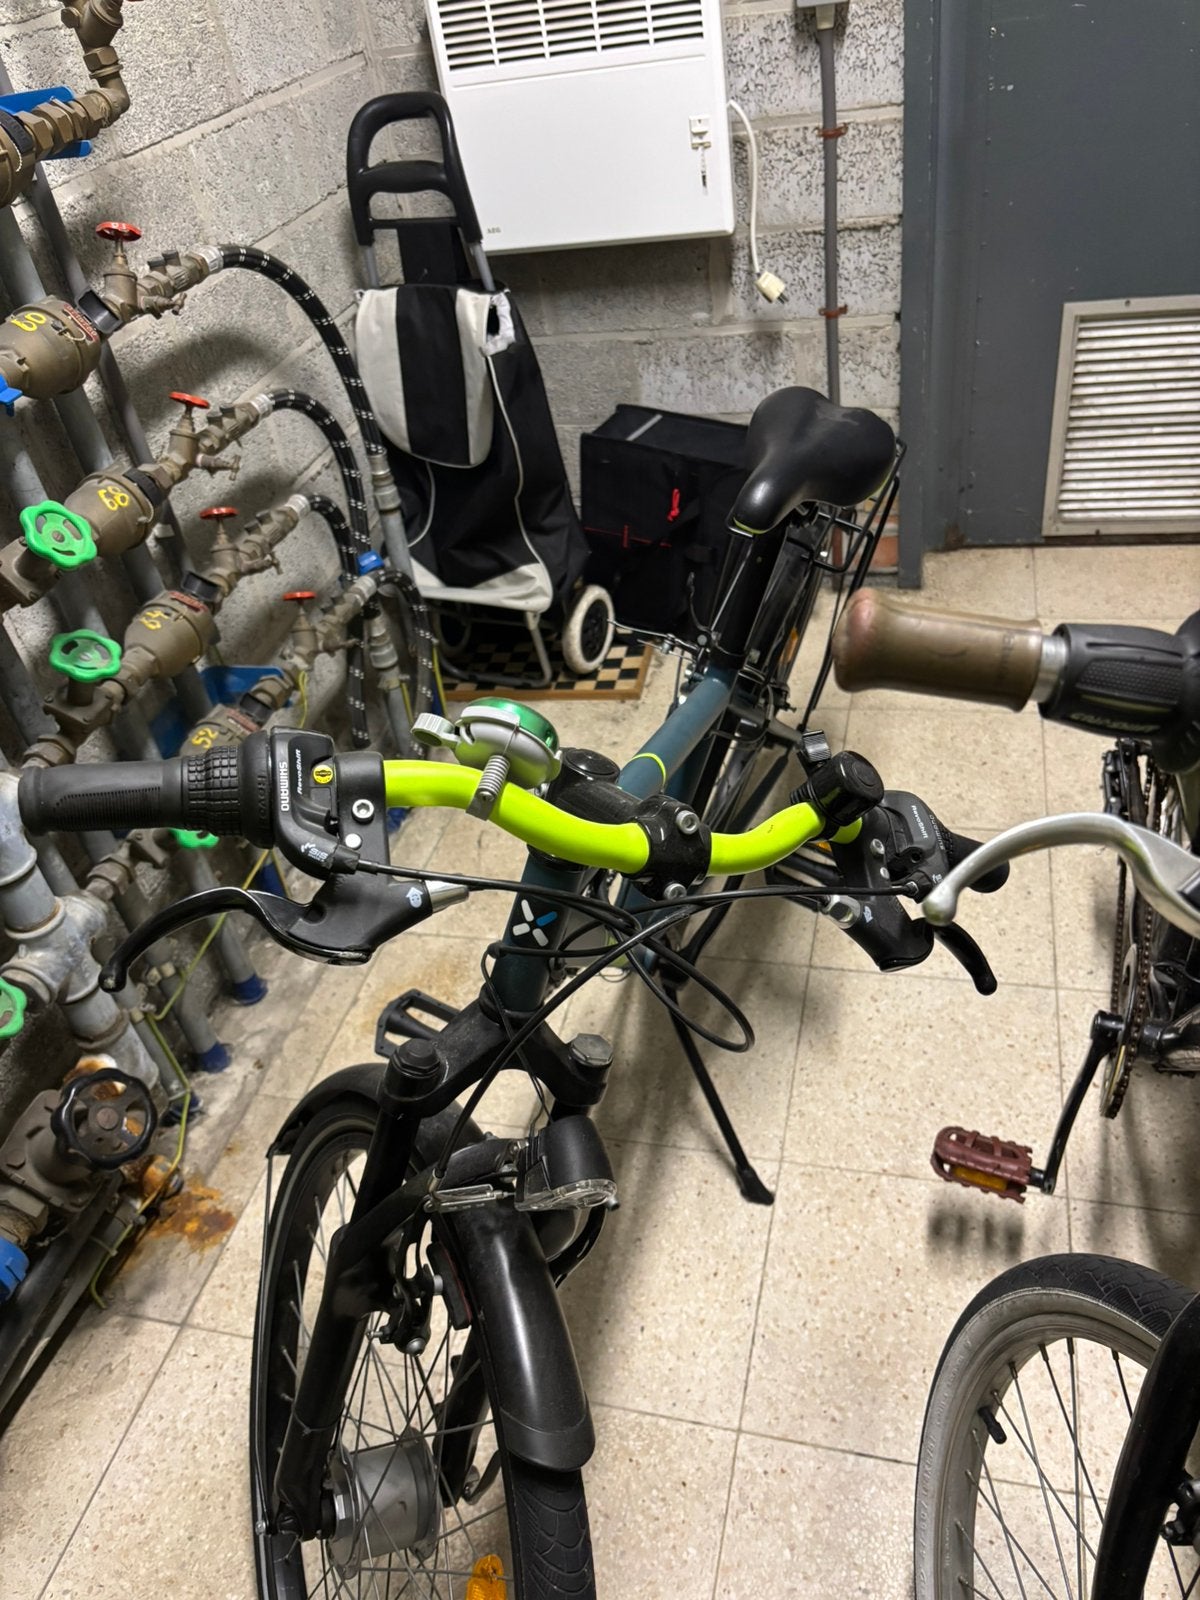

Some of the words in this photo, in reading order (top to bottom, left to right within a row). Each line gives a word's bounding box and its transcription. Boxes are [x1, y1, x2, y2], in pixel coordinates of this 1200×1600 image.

[11, 312, 47, 332] 60
[98, 485, 130, 512] 68
[192, 727, 219, 750] 52
[279, 761, 290, 812] SHIMANO
